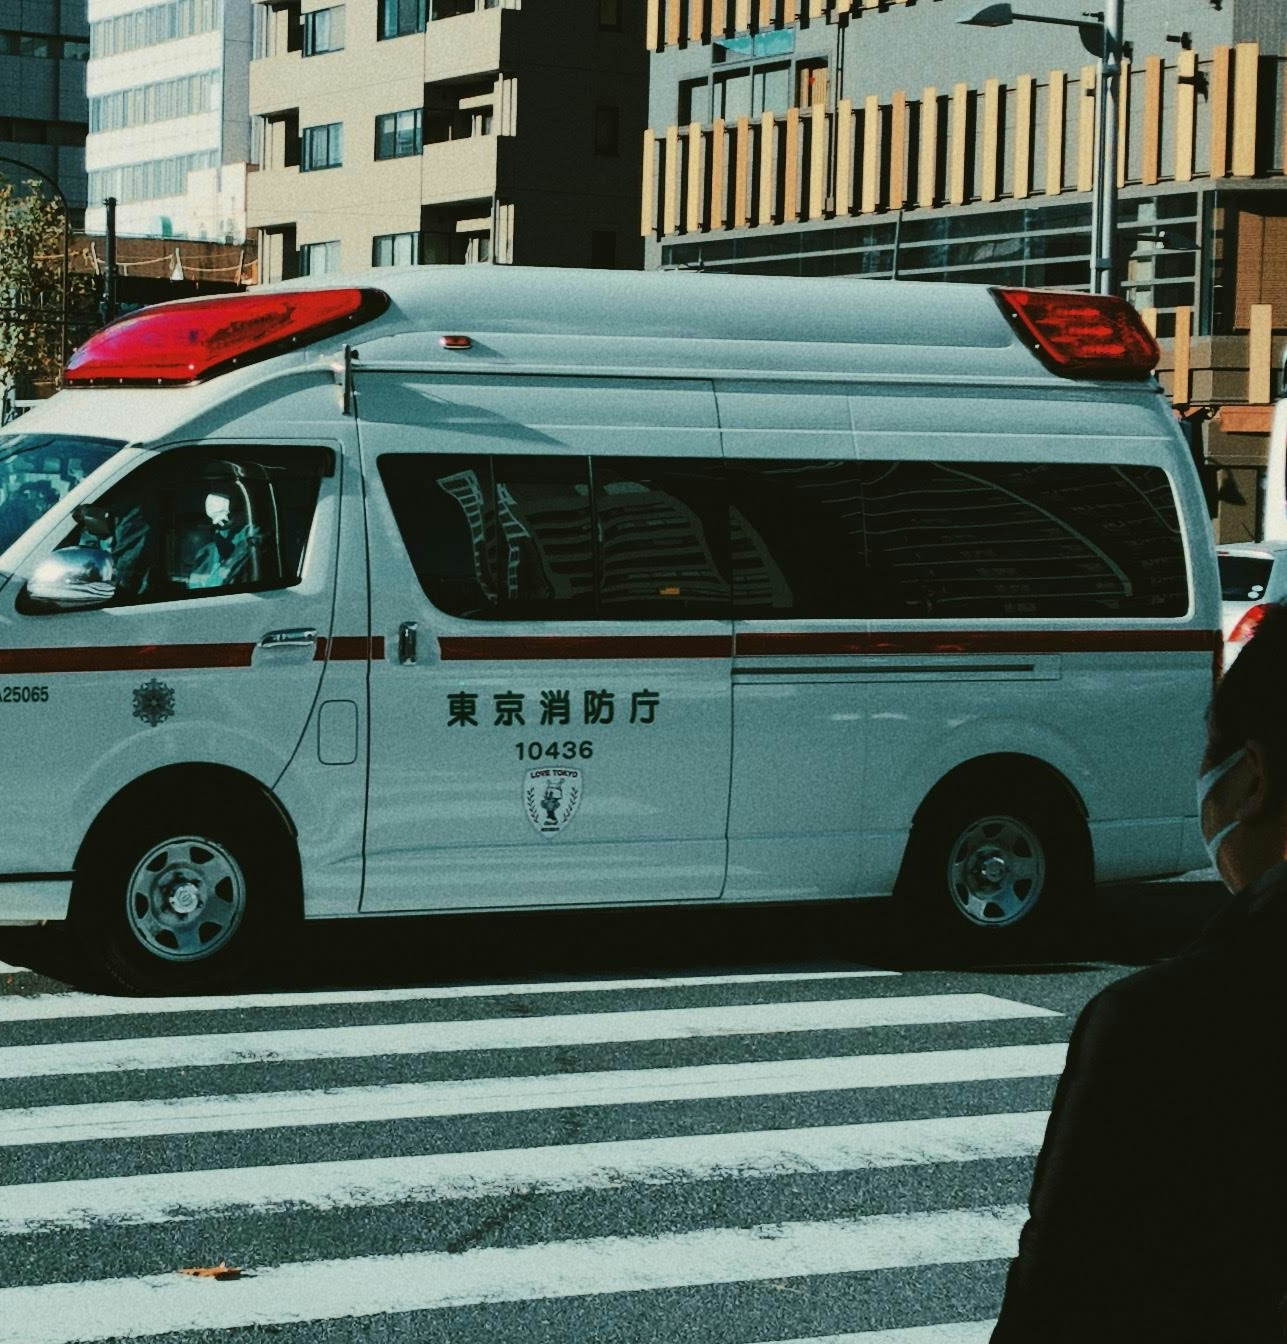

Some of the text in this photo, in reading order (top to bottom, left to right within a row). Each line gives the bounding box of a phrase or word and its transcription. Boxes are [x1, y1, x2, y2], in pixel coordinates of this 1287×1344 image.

[447, 688, 660, 727] 東京消防庁
[515, 740, 594, 761] 10436
[552, 768, 578, 779] TOKYO
